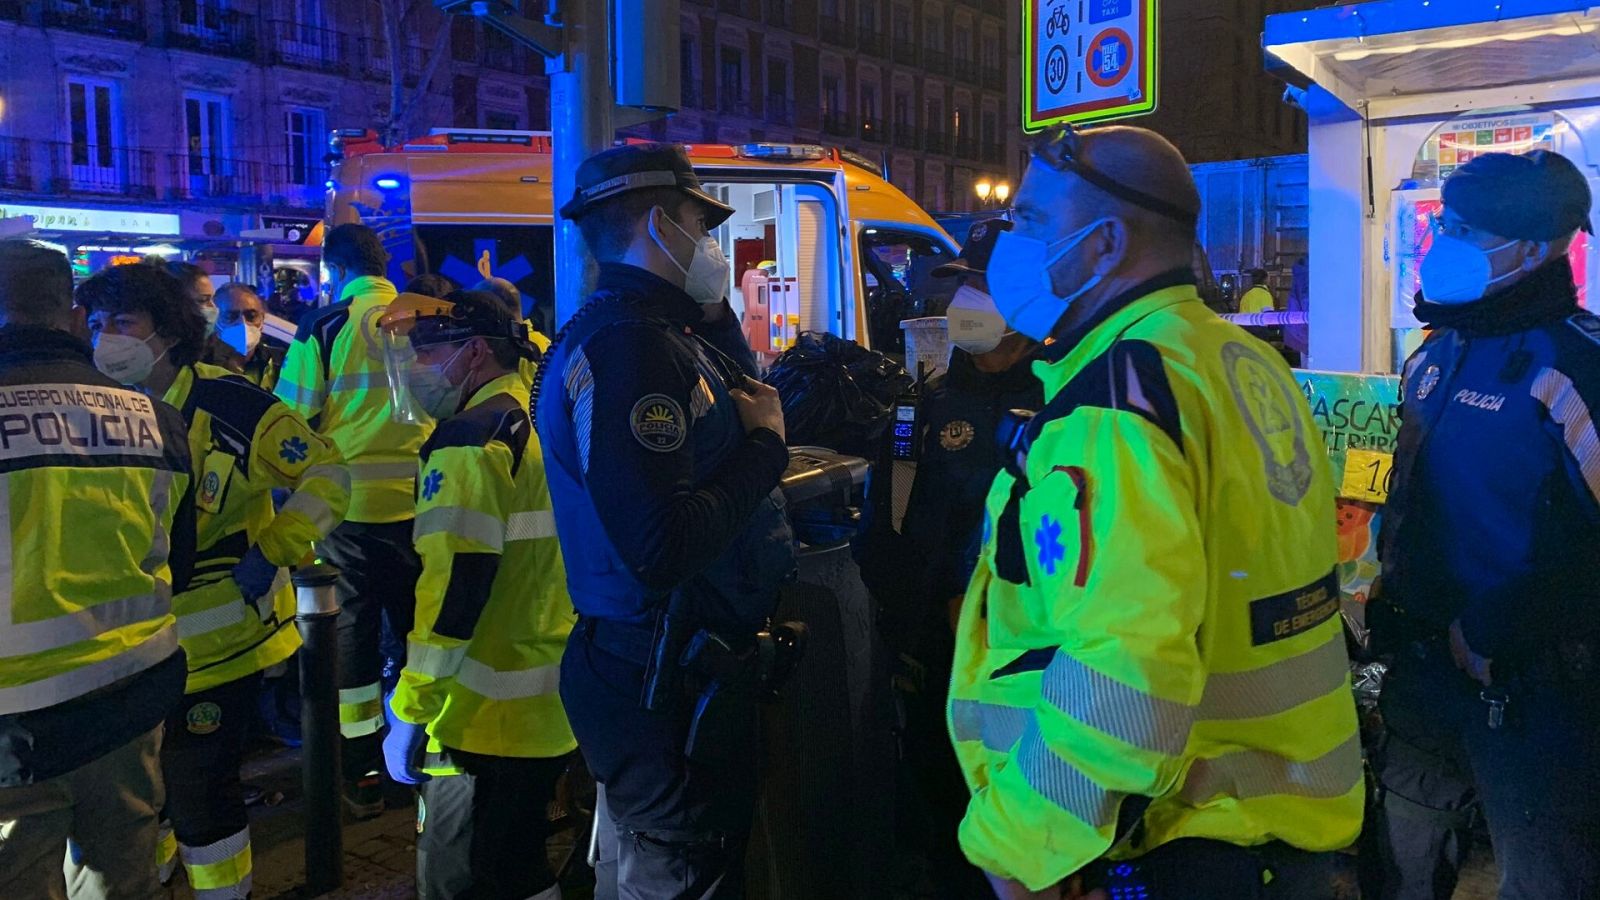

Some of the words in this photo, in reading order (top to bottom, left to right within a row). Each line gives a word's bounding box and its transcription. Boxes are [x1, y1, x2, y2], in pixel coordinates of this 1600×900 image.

[1102, 6, 1120, 17] TAXI
[1050, 57, 1064, 82] 30
[1103, 53, 1118, 72] 54
[1461, 119, 1511, 130] OBJETIVOS
[0, 390, 61, 408] CUERPO
[65, 391, 131, 411] NACIONAL
[132, 397, 150, 413] DE
[1, 412, 158, 449] POLICIA
[1273, 619, 1291, 635] DE
